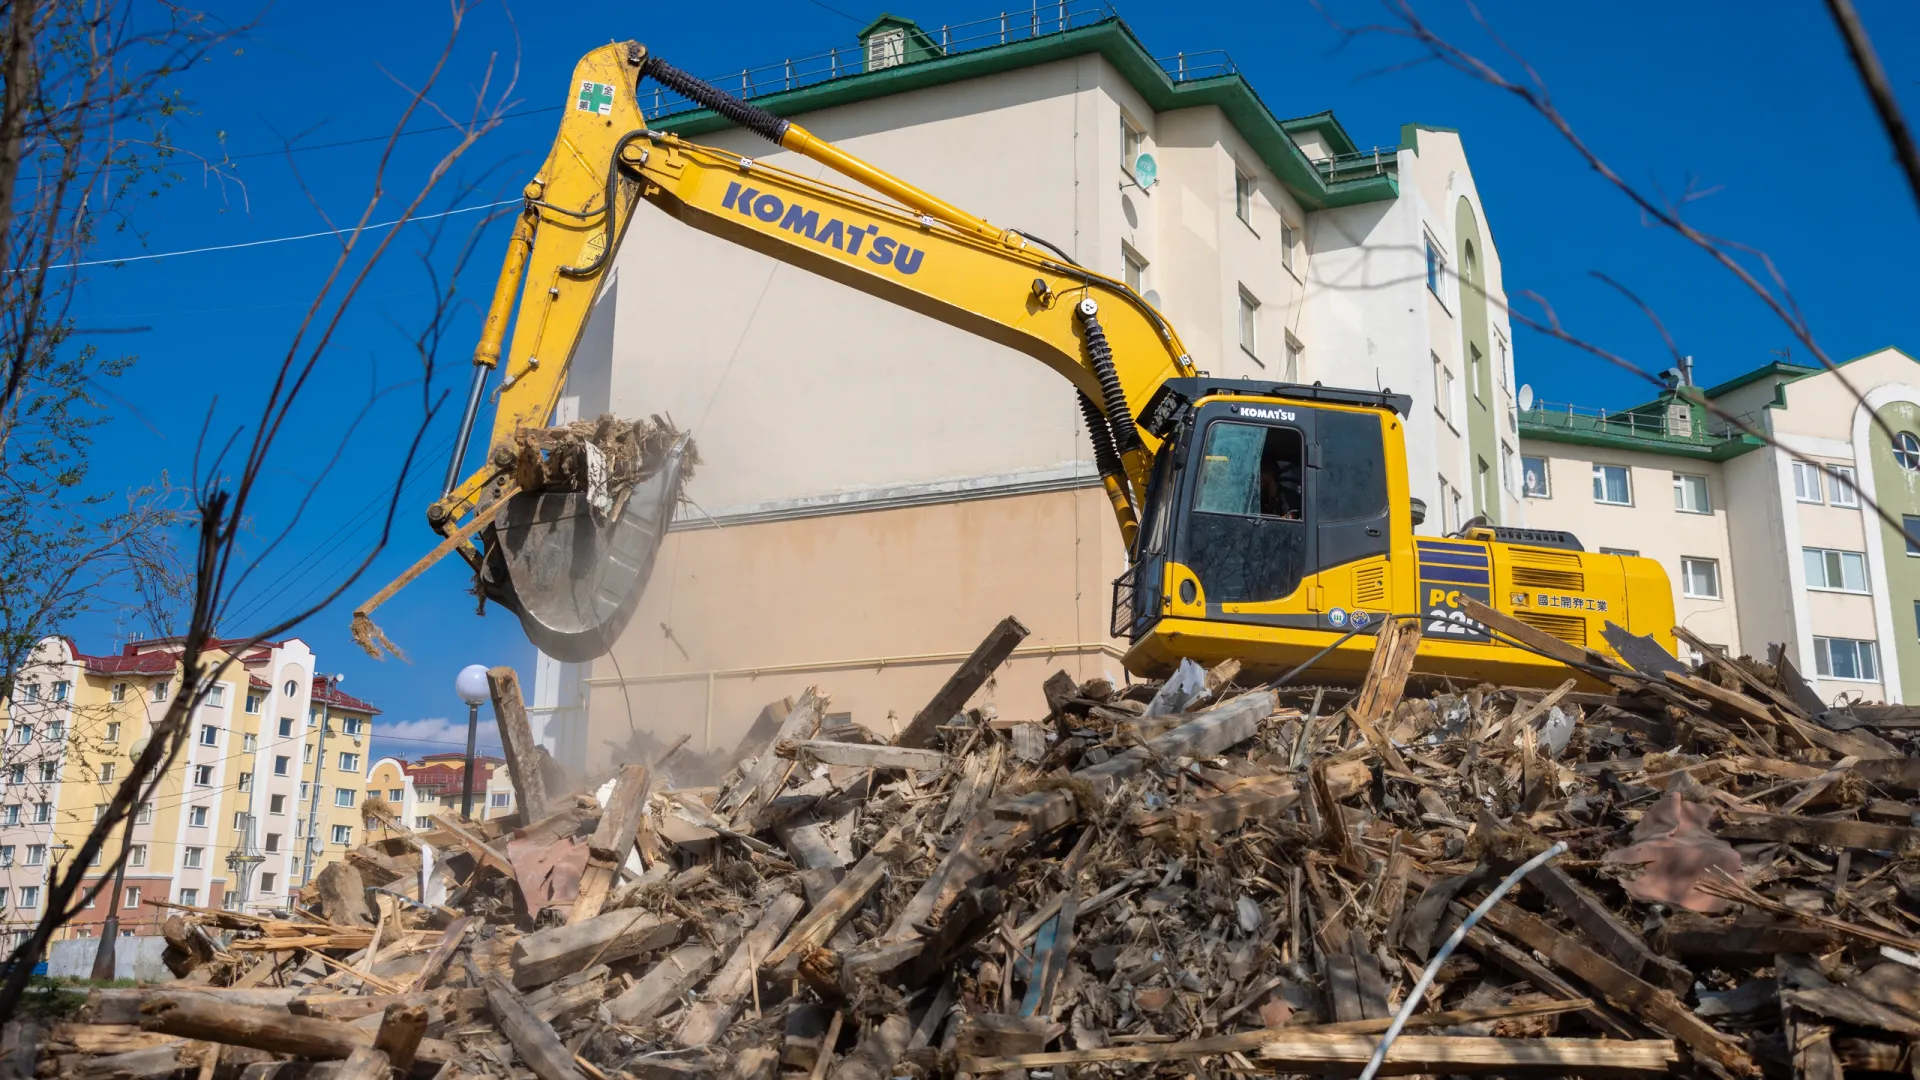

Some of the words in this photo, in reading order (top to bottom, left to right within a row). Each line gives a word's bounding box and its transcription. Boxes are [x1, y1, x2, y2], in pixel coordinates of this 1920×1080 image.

[721, 181, 925, 275] KOMATSU
[1240, 407, 1296, 421] KOMATSU
[1429, 589, 1460, 608] PC
